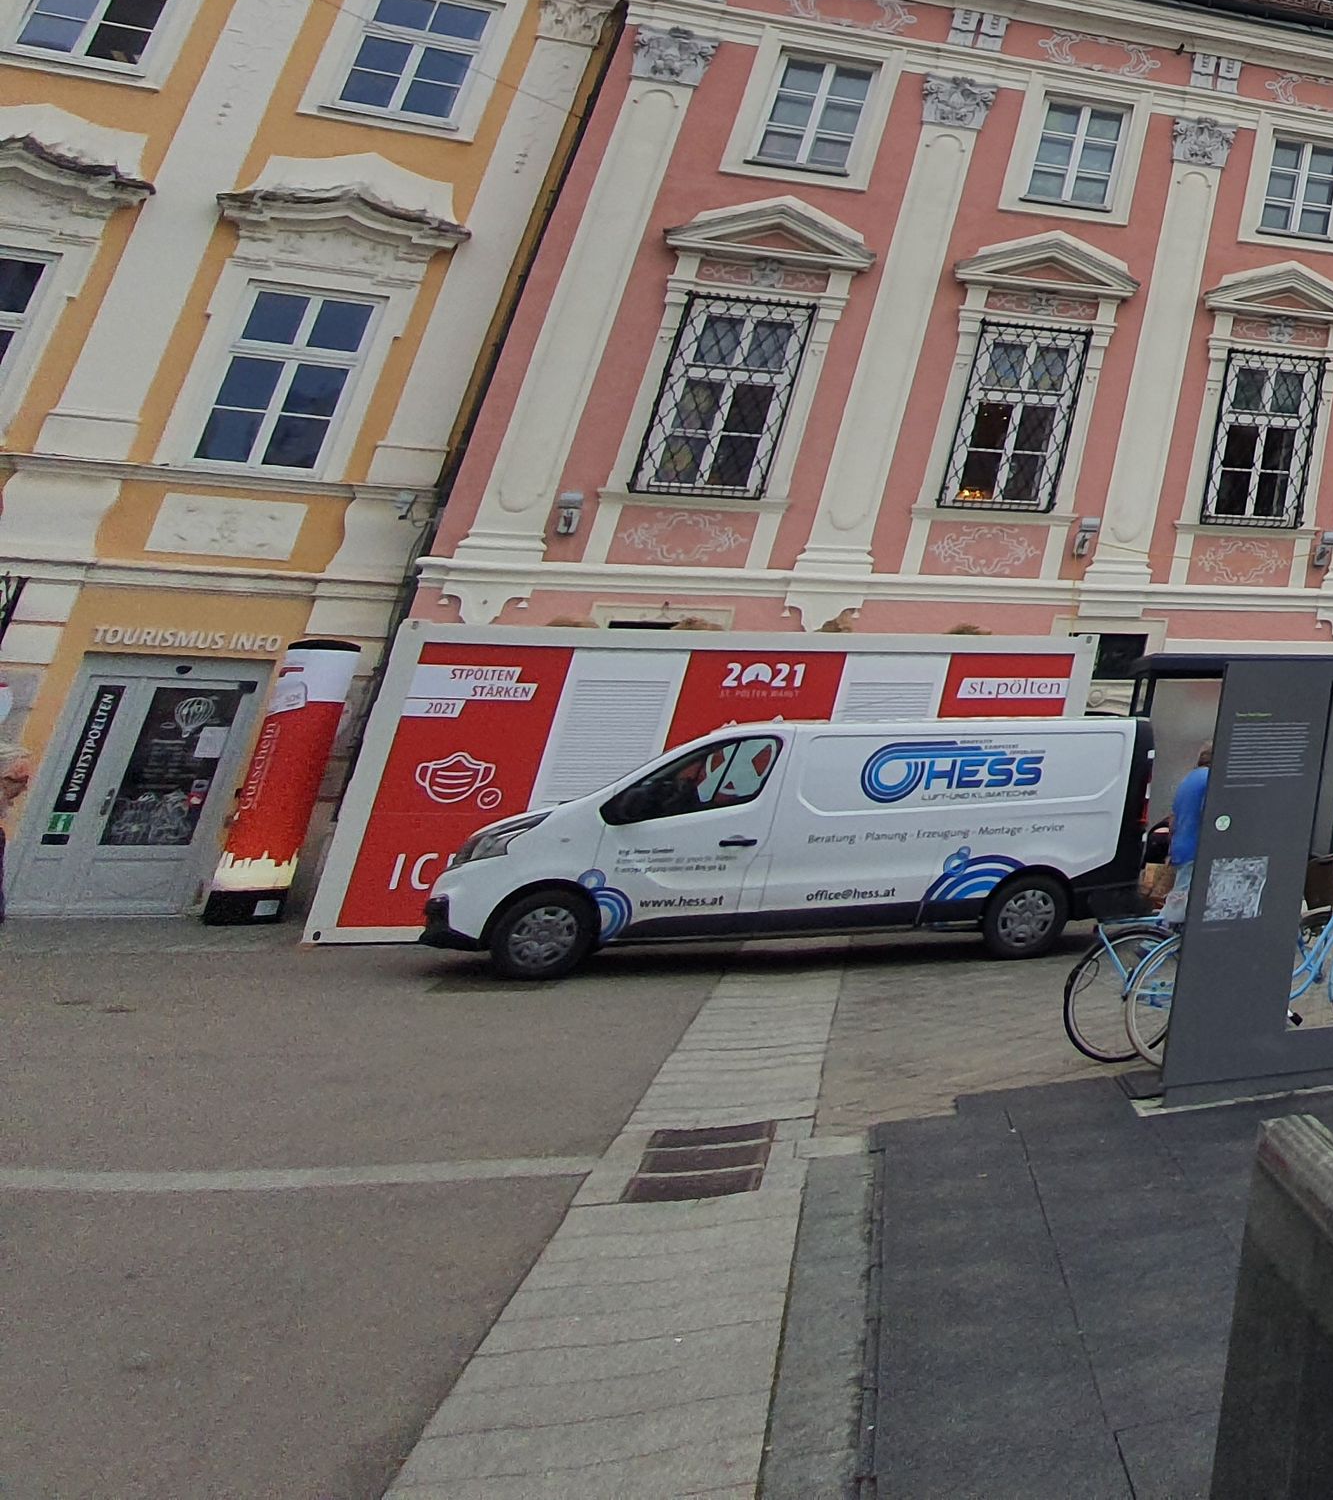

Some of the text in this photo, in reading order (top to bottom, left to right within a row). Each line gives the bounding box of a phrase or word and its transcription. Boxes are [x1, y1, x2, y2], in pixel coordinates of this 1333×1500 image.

[94, 625, 283, 652] TOURISMUS INFO
[450, 668, 516, 682] STPÖLTEN
[471, 684, 532, 699] STÄRKEN
[425, 701, 457, 715] 2021
[924, 755, 1045, 791] HESS
[807, 833, 857, 845] Beratung
[865, 831, 908, 842] Planung
[978, 825, 1024, 836] Montage
[1031, 822, 1065, 834] Service
[388, 852, 457, 890] IC
[639, 895, 724, 908] www.hess.at
[806, 886, 896, 902] office@hess.at
